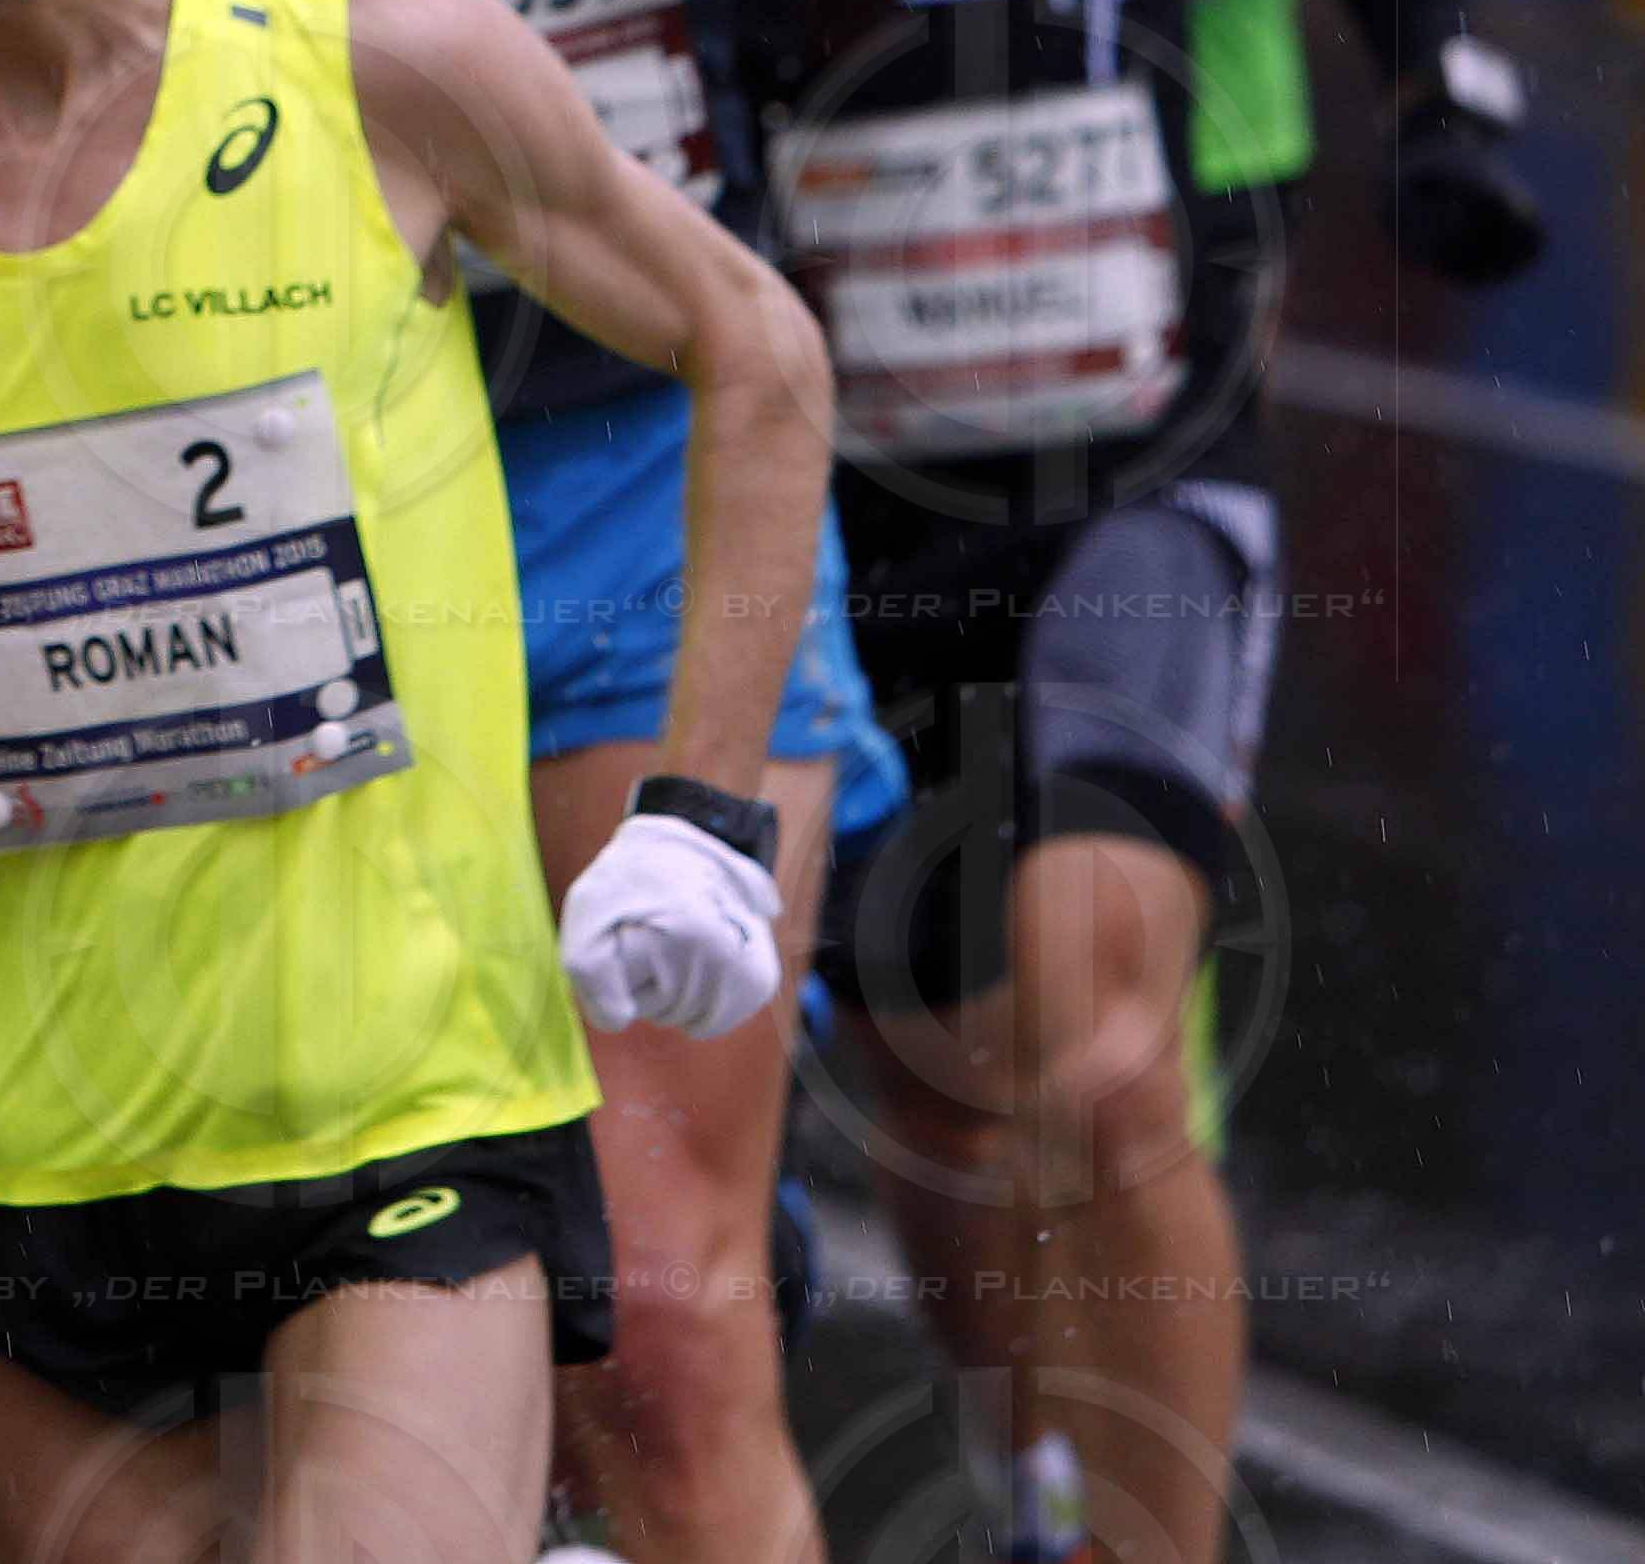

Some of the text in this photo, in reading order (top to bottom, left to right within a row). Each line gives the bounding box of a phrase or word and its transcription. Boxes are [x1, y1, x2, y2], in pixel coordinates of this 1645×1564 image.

[129, 279, 333, 322] LC VILLACH
[179, 439, 246, 530] 2
[43, 609, 241, 692] ROMAN
